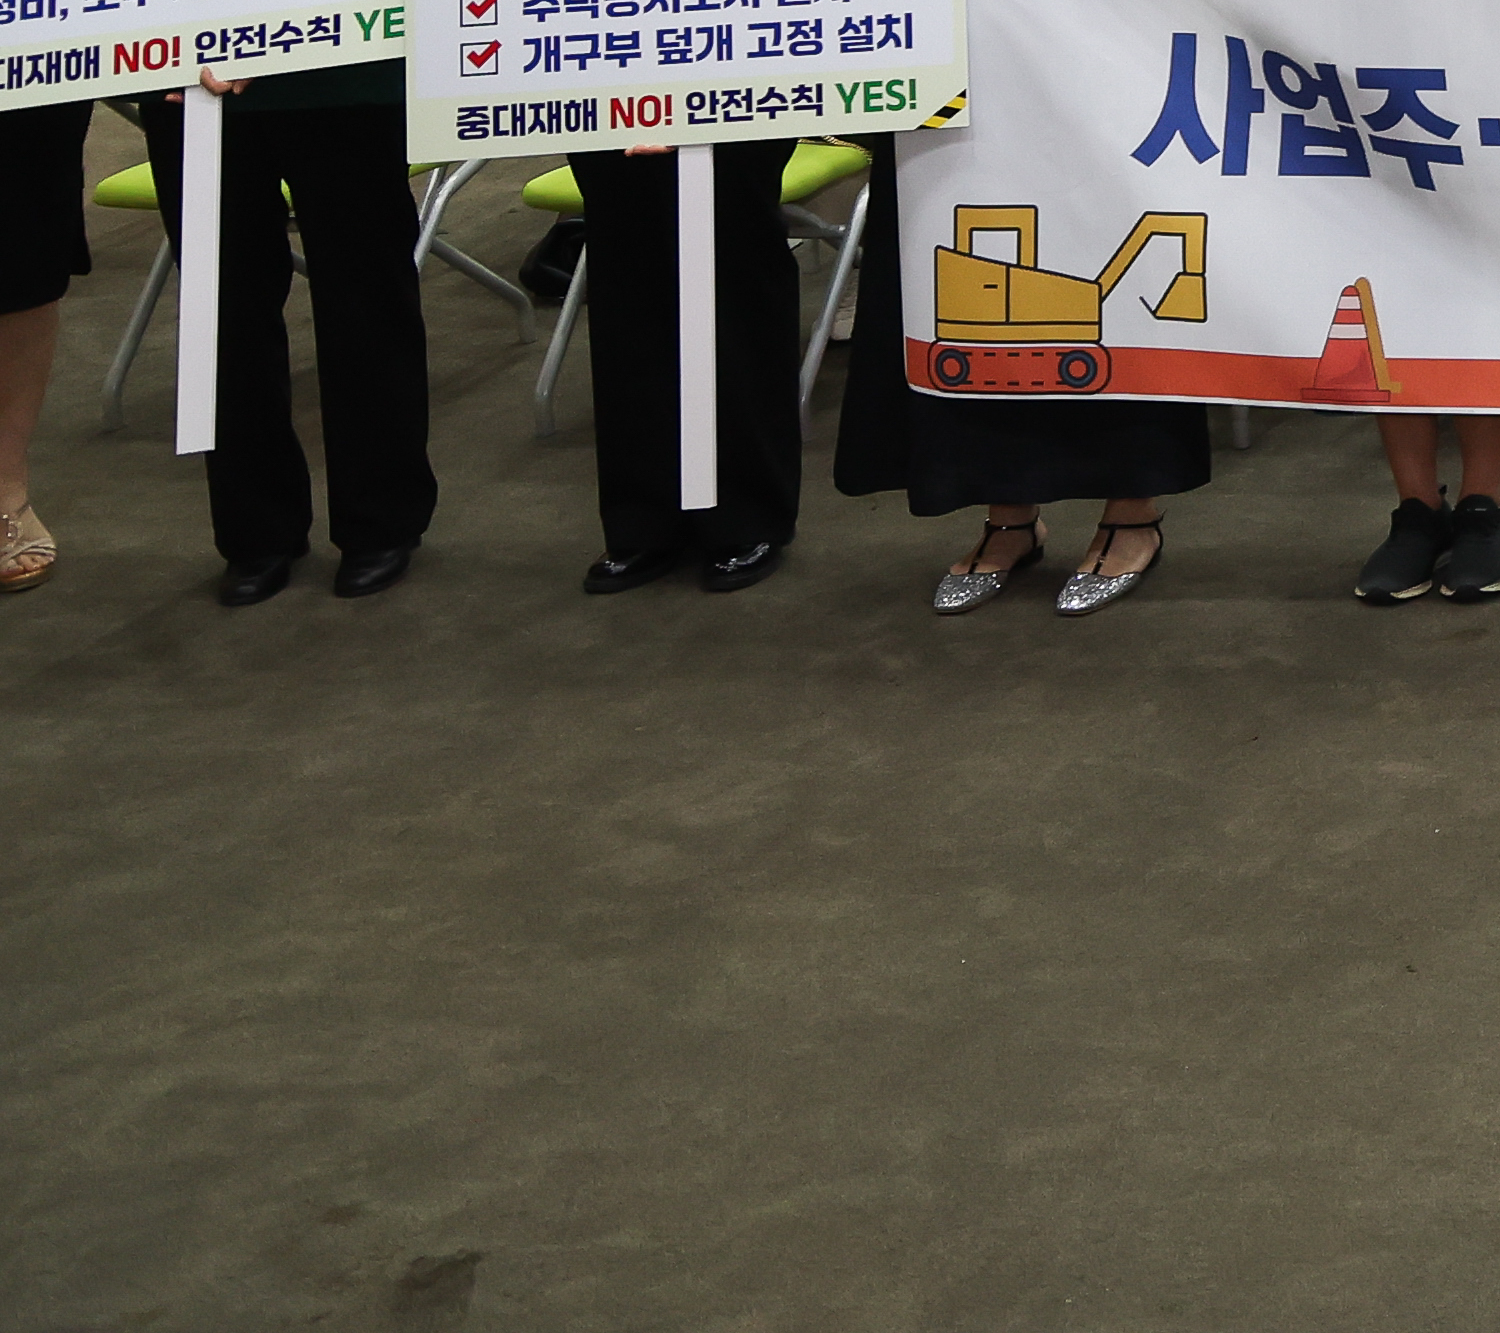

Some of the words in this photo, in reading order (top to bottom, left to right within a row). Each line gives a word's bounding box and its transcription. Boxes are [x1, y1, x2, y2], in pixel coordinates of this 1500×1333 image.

[113, 35, 181, 76] NO!
[195, 13, 343, 65] 안전수칙
[522, 33, 643, 76] 개구부
[656, 26, 734, 68] 덮개
[746, 20, 824, 60] 고정
[837, 12, 914, 53] 설치
[455, 96, 598, 142] 중대재해
[609, 94, 673, 131] NO!
[685, 82, 825, 126] 안전수칙
[836, 78, 918, 115] YES!
